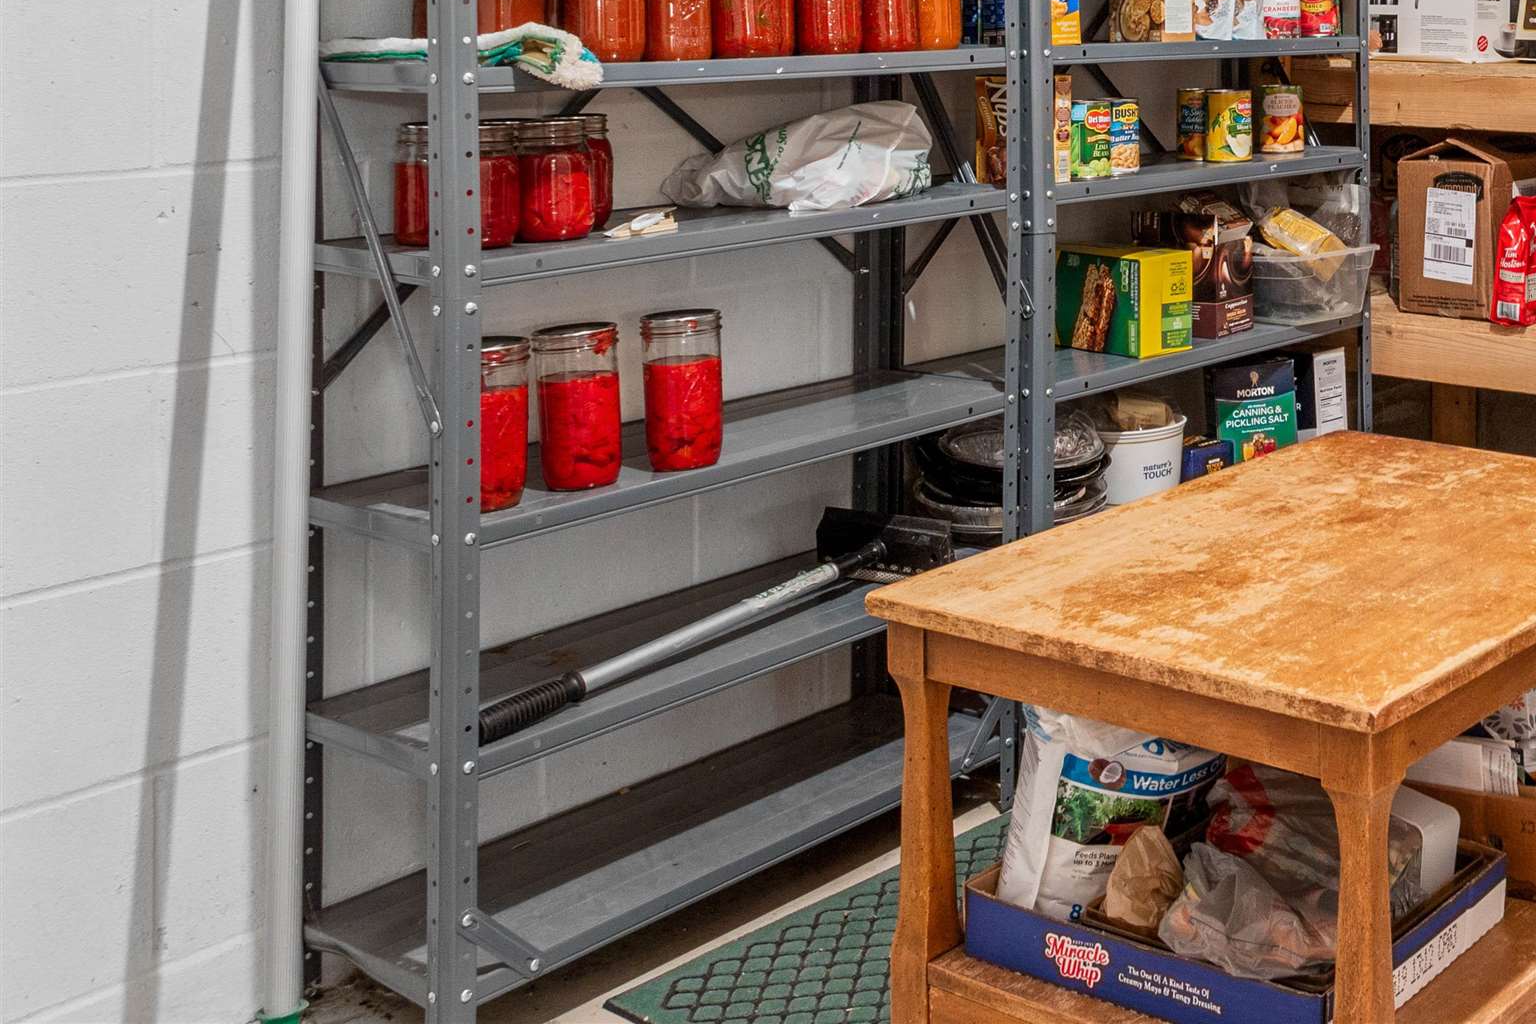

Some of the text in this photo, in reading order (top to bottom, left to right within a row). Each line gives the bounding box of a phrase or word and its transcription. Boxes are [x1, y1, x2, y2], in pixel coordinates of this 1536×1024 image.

[1505, 248, 1517, 258] Tim
[1500, 257, 1526, 269] Hortons
[1237, 386, 1275, 398] MORTON
[1233, 406, 1282, 418] CANNING &
[1226, 413, 1289, 428] PICKLING SALT
[1143, 461, 1172, 472] nature's
[1143, 469, 1172, 480] TOUCH
[1132, 768, 1208, 791] Water Less
[1075, 851, 1097, 860] Feeds
[1070, 904, 1082, 920] 8
[1045, 933, 1109, 965] Miracle
[1056, 955, 1101, 988] Whip
[1128, 965, 1210, 998] The One Of A Kind Taste Of
[1118, 973, 1222, 1015] Creamy Mayo & Tangy Dressing
